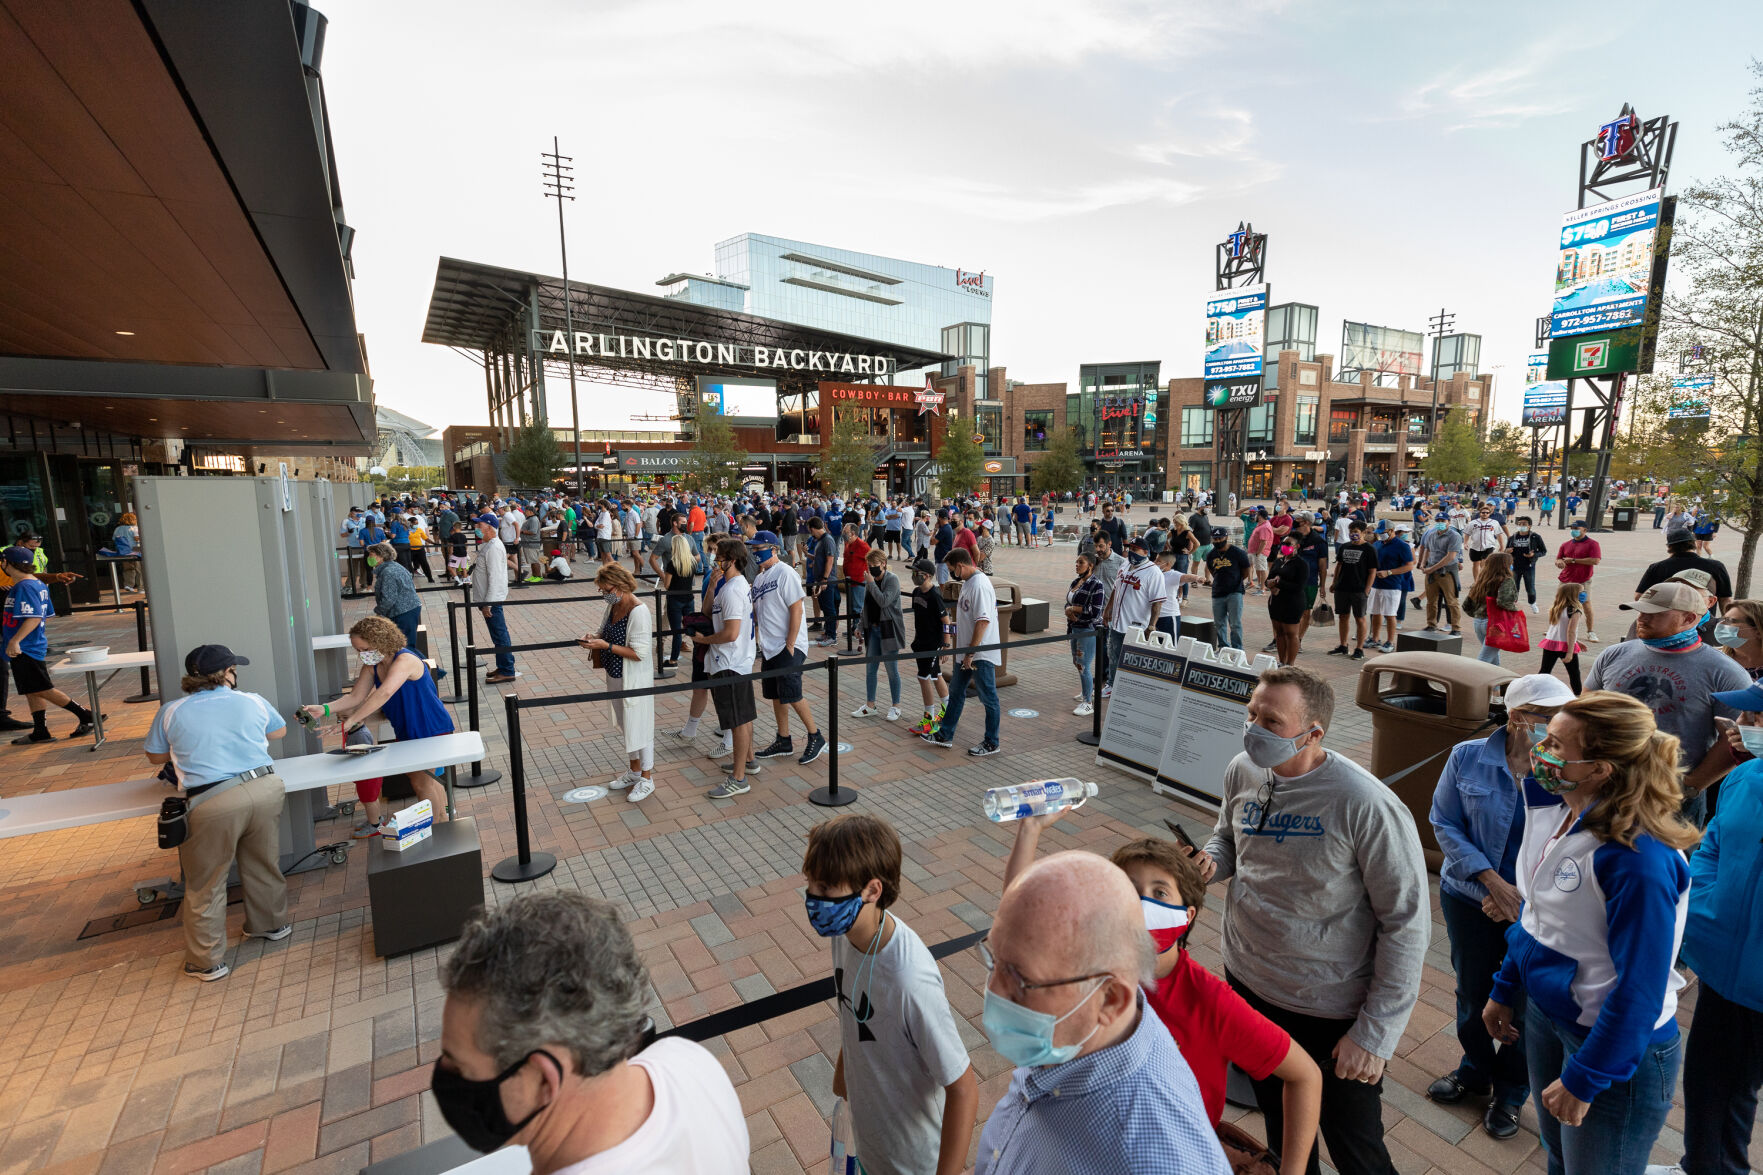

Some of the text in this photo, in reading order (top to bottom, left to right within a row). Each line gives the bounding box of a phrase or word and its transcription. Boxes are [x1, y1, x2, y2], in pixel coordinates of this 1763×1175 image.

[1590, 204, 1619, 215] SPRINGS
[1620, 193, 1657, 208] CROSSING
[1561, 219, 1610, 245] $750
[956, 267, 984, 288] Live!
[1207, 300, 1237, 316] $750
[1553, 299, 1644, 319] CARROLLTON APARTMENTS
[549, 330, 735, 365] ARLINGTON
[754, 346, 888, 375] BACKYARD
[832, 388, 909, 402] COWBOY BAR
[1229, 394, 1255, 404] energy
[1230, 383, 1258, 397] TXU
[1094, 396, 1146, 407] TEXAS
[1102, 402, 1138, 421] Live!
[1532, 408, 1560, 419] Live!
[1095, 448, 1119, 459] Live!
[20, 601, 34, 614] LA
[1122, 652, 1175, 675] POSTSEASON
[1188, 670, 1249, 696] POSTSEASON
[1622, 665, 1687, 691] LEVI STRAUSS
[1241, 801, 1325, 843] Ddgers
